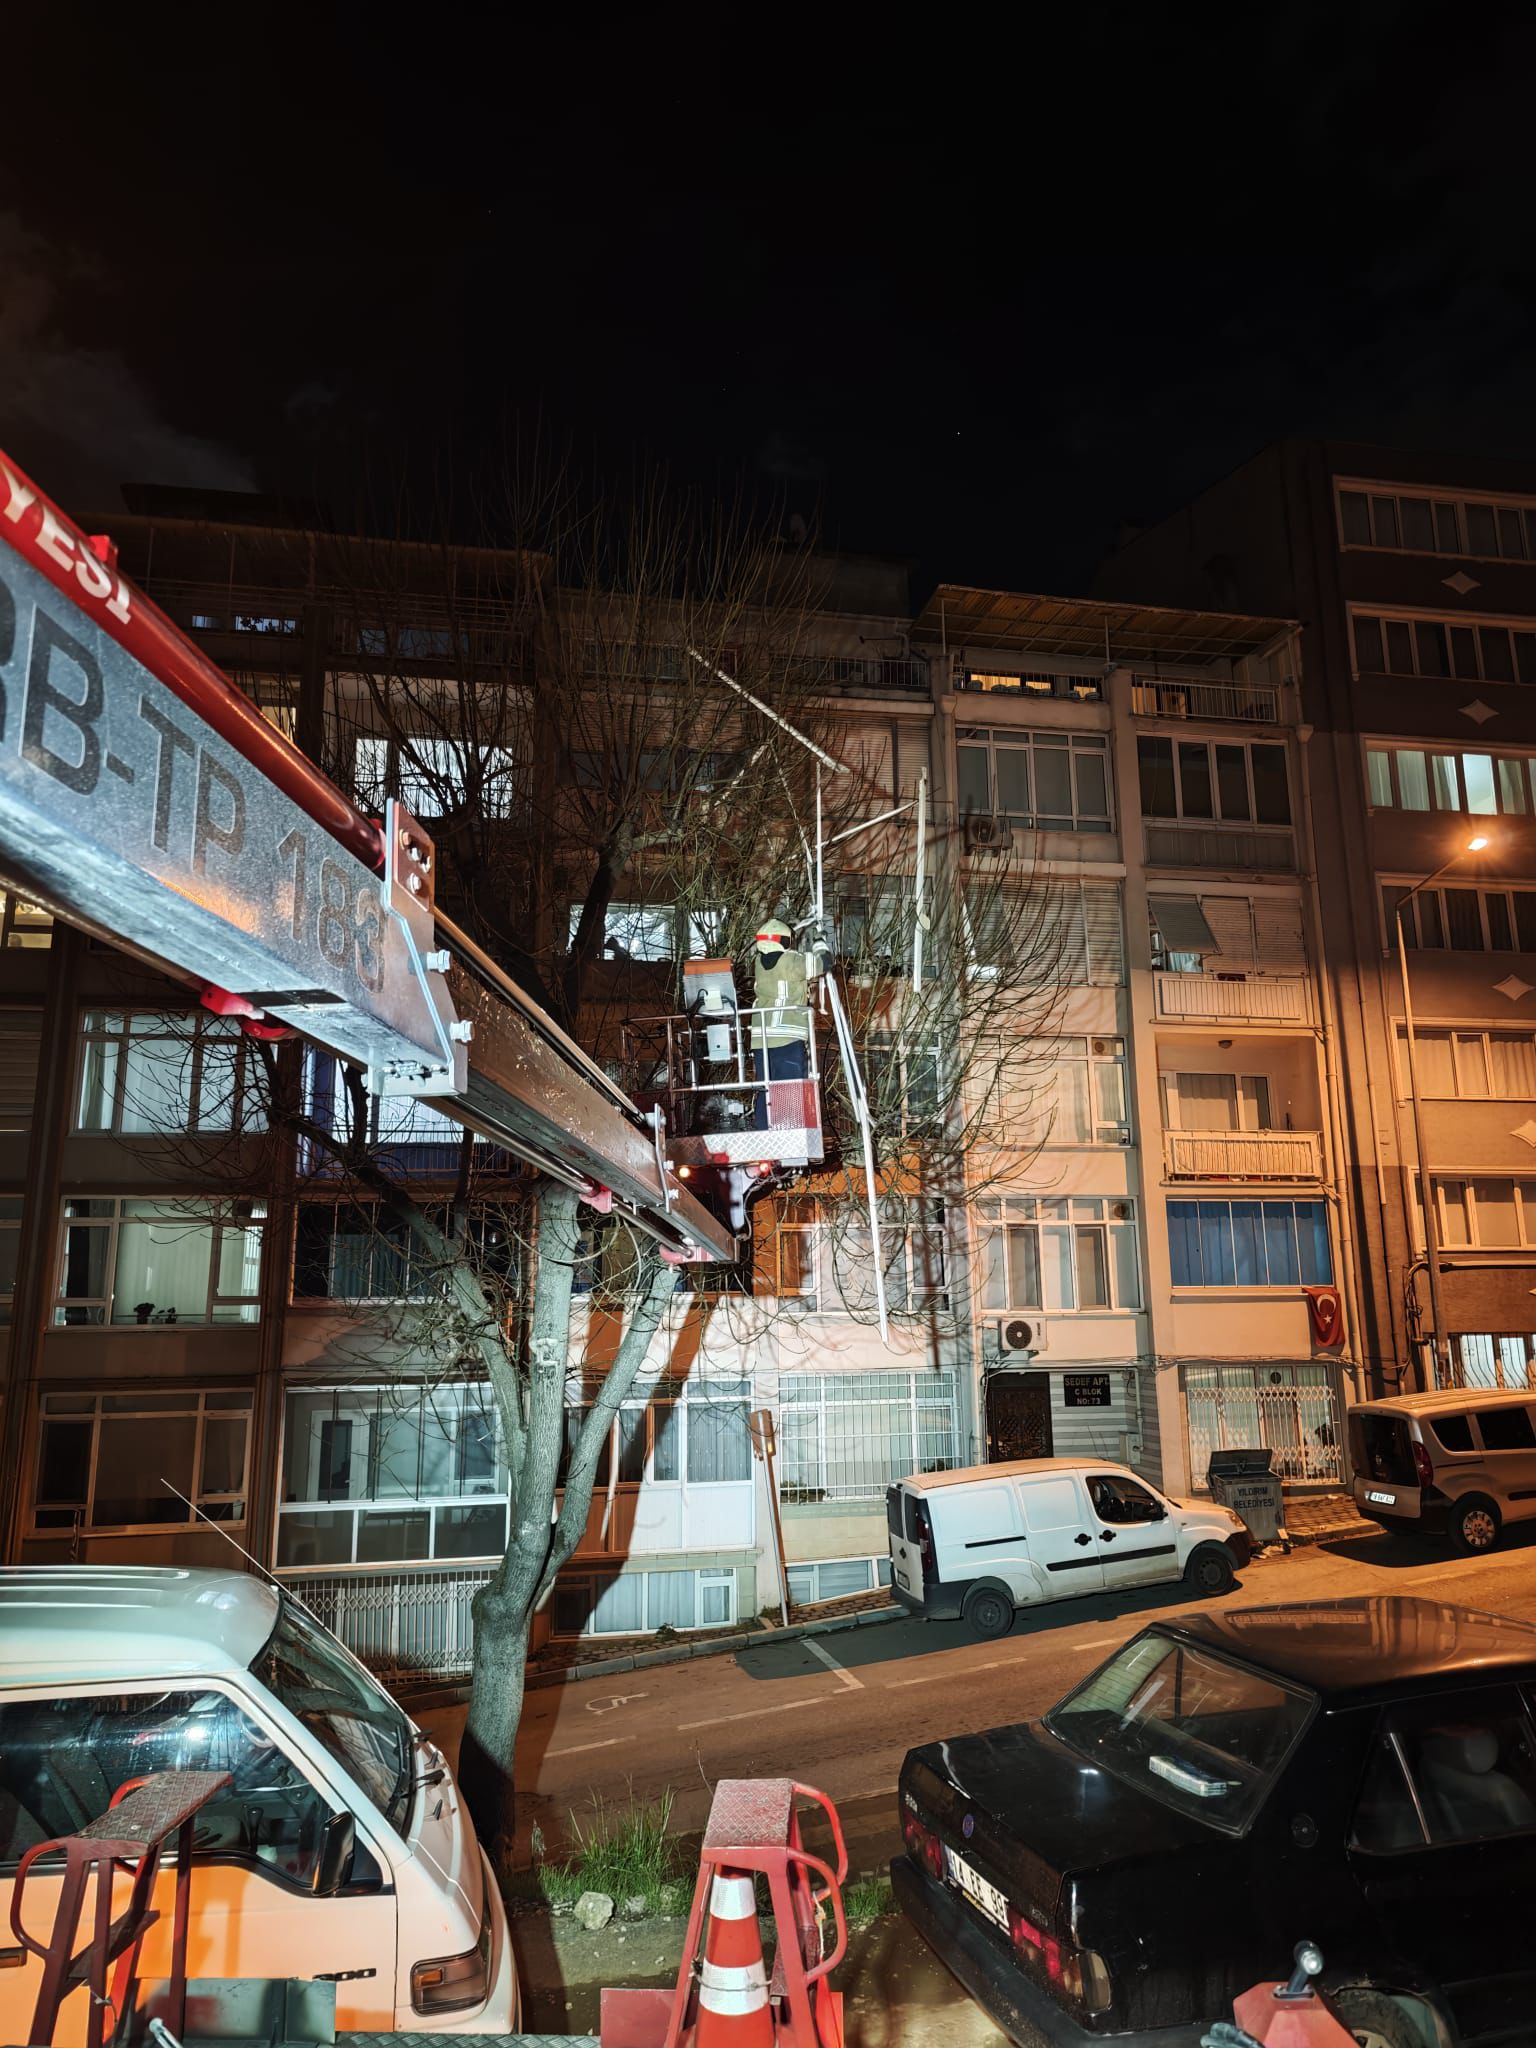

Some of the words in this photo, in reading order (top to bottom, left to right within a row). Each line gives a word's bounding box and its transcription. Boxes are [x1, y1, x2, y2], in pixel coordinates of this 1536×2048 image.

[0, 575, 247, 877] B-TP
[277, 827, 384, 992] 183
[1082, 1388, 1102, 1396] BLOK
